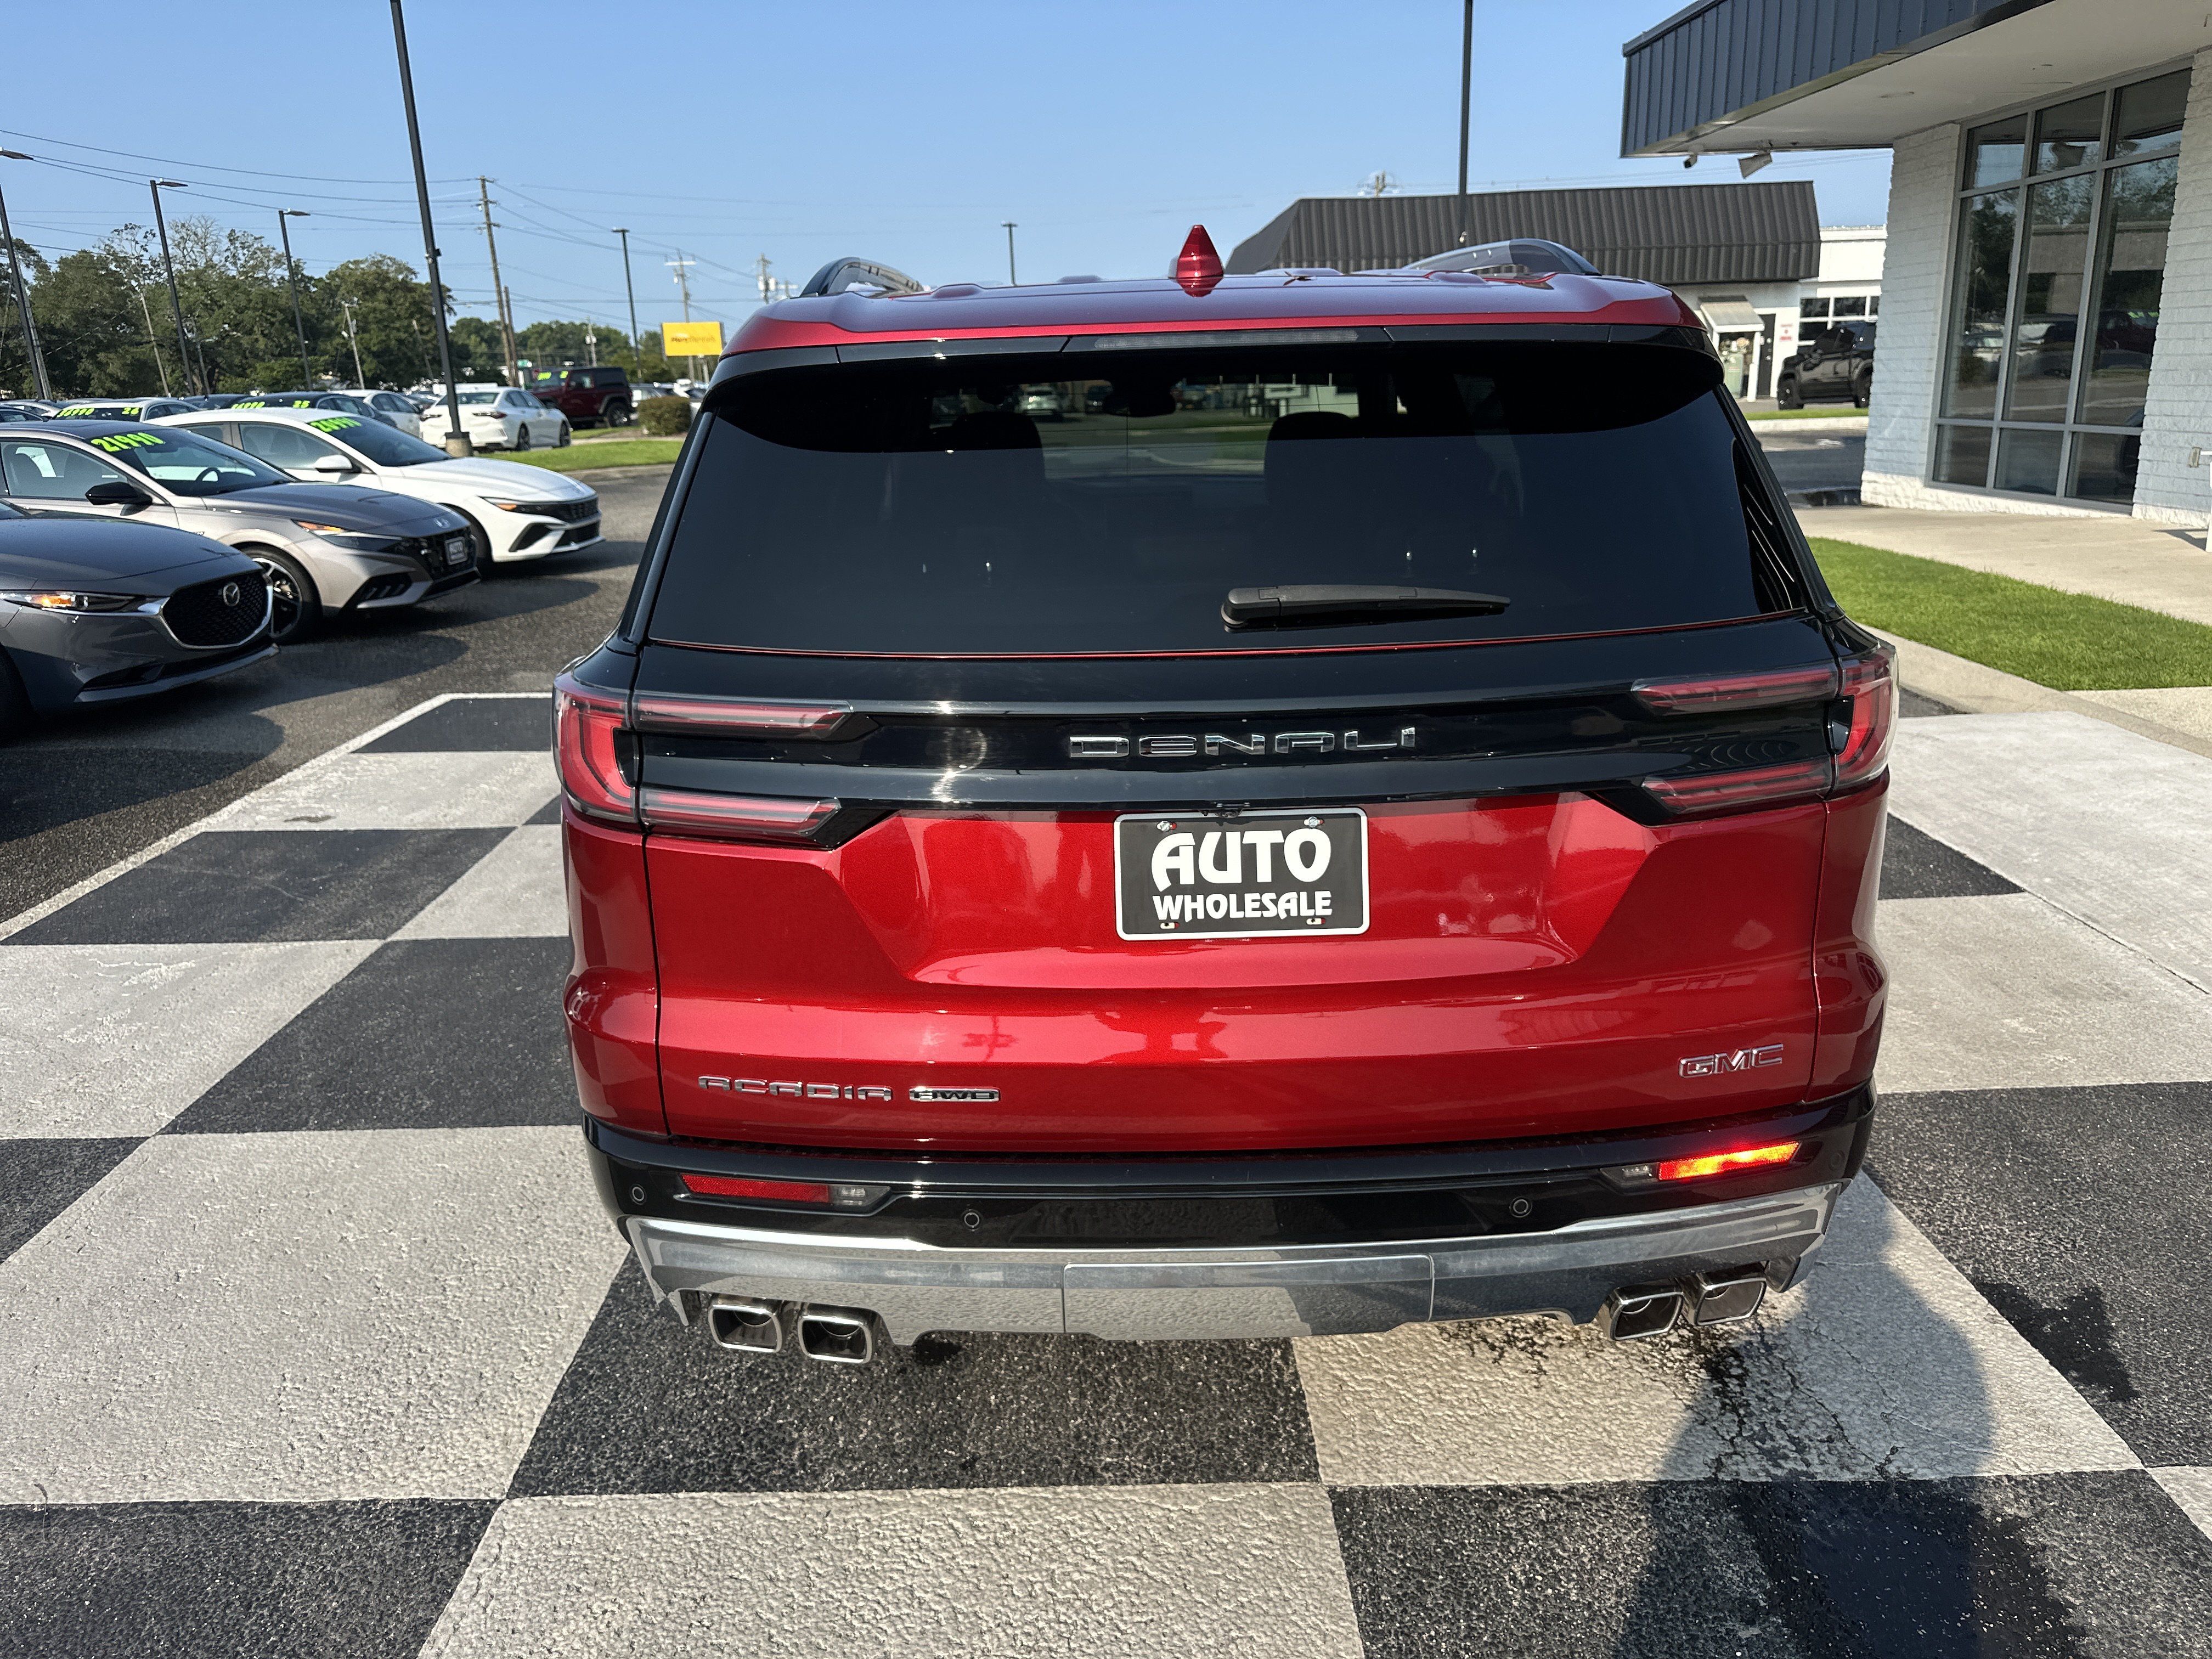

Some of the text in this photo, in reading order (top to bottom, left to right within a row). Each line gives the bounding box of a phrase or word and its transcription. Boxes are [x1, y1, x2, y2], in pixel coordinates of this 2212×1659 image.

[91, 432, 166, 452] 21990
[1069, 727, 1415, 758] DENALI
[1151, 828, 1331, 892] AUTO
[1152, 890, 1333, 923] WHOLESALE
[1678, 1043, 1784, 1079] GMC
[698, 1075, 892, 1102] ACADIA
